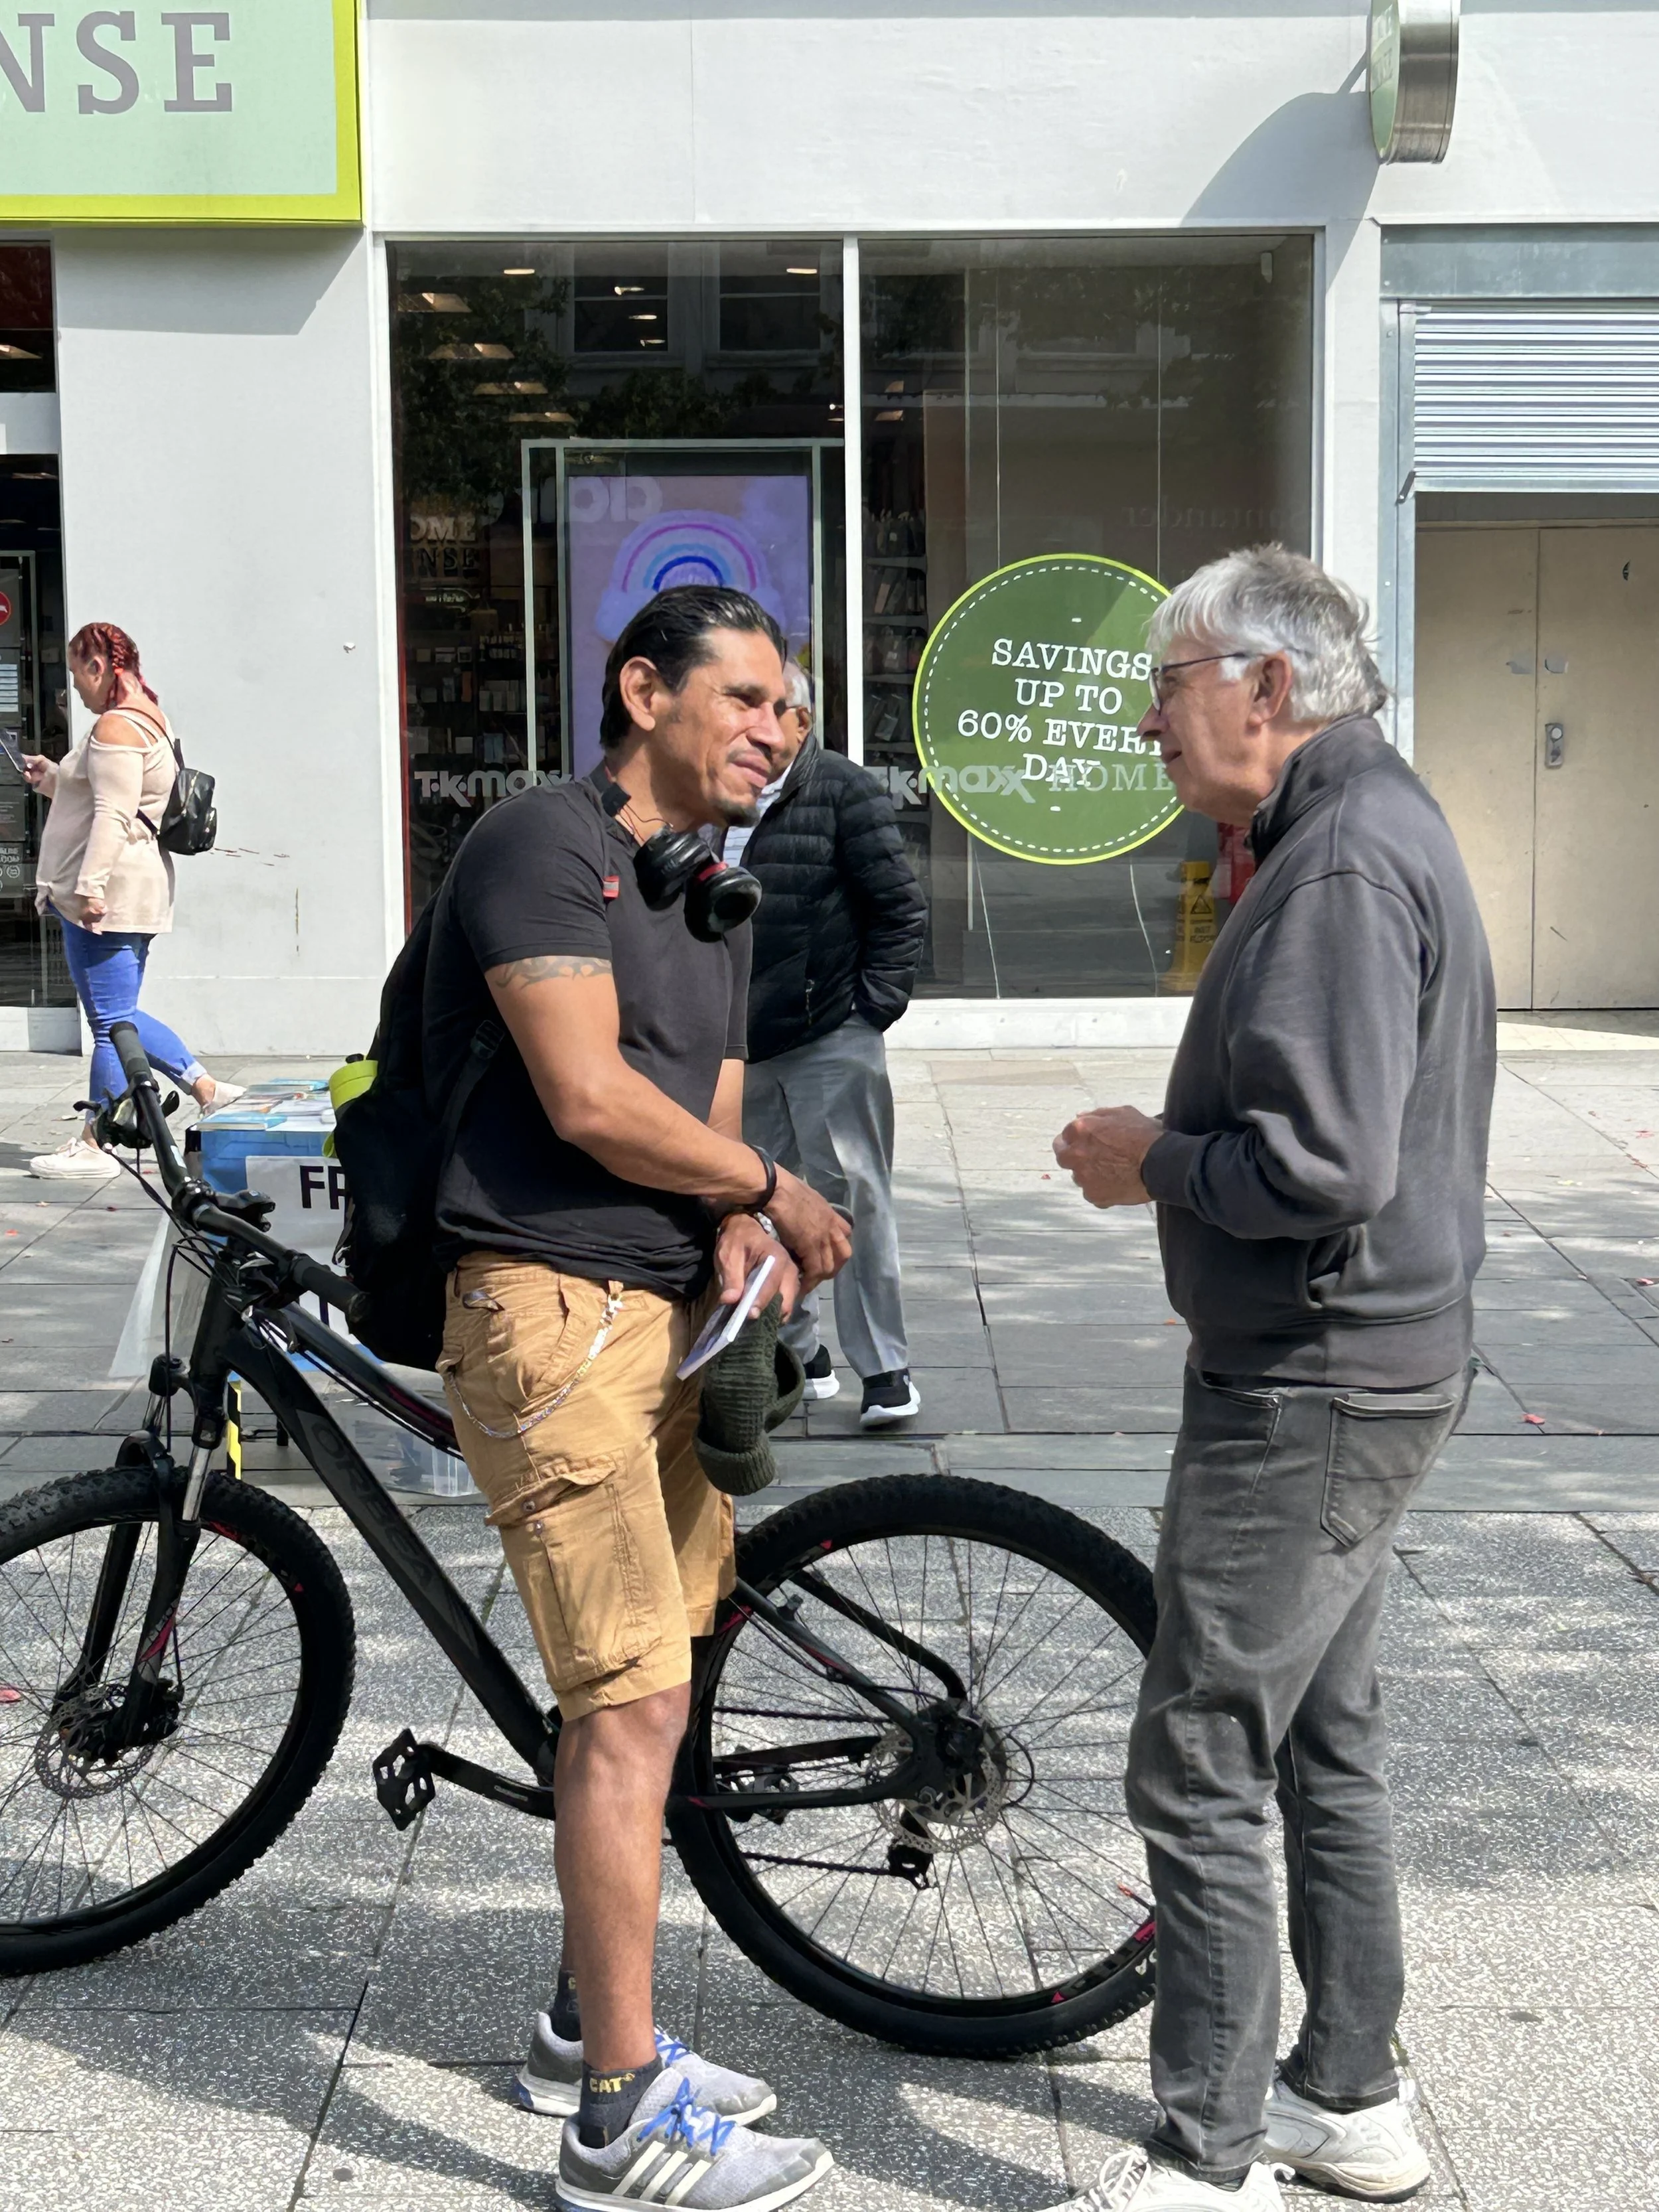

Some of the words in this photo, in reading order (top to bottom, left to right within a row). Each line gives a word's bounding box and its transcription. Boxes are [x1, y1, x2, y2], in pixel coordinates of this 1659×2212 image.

[0, 11, 232, 114] NSE
[991, 638, 1153, 681] SAVINGS
[1015, 678, 1064, 708] UP
[1075, 684, 1122, 715] TO
[958, 709, 1033, 743] 60%
[1022, 753, 1102, 787] DAY
[1050, 763, 1175, 792] HOME
